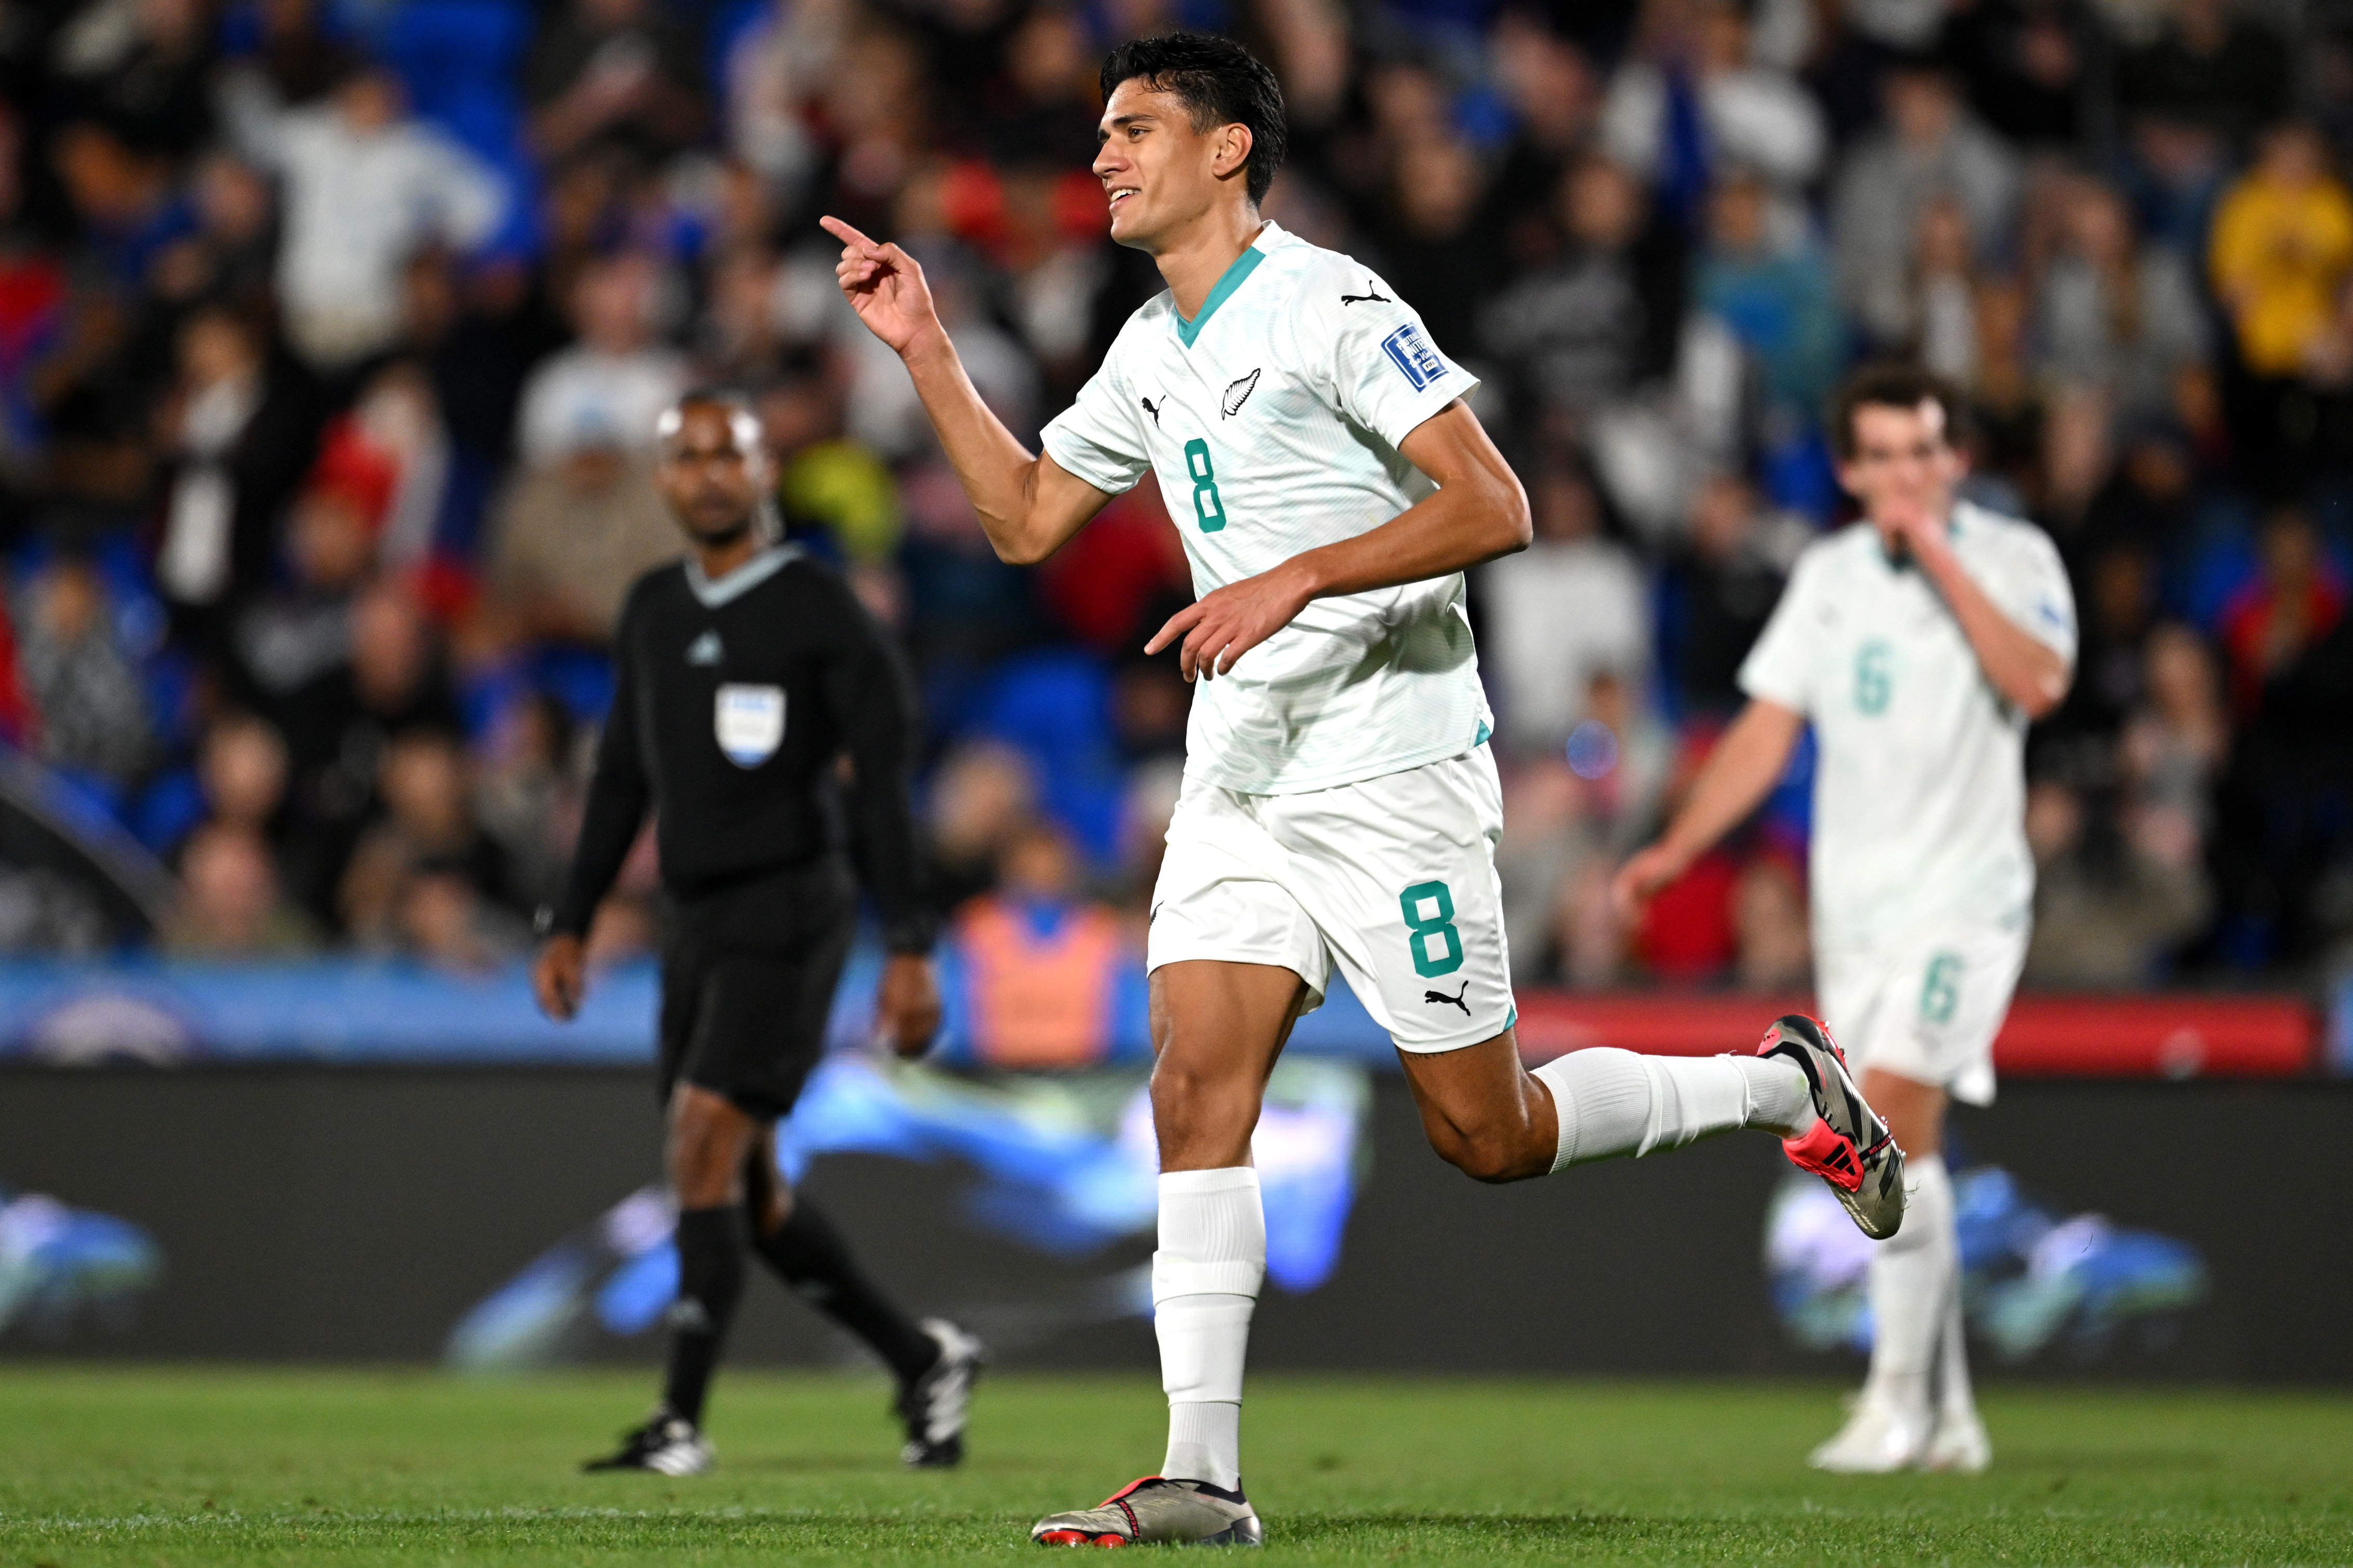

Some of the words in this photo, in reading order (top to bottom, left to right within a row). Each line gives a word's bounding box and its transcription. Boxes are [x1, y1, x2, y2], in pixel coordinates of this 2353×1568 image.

[1184, 438, 1227, 533] 8
[1851, 637, 1894, 717] 6
[1399, 880, 1464, 979] 8
[1918, 950, 1965, 1024] 6
